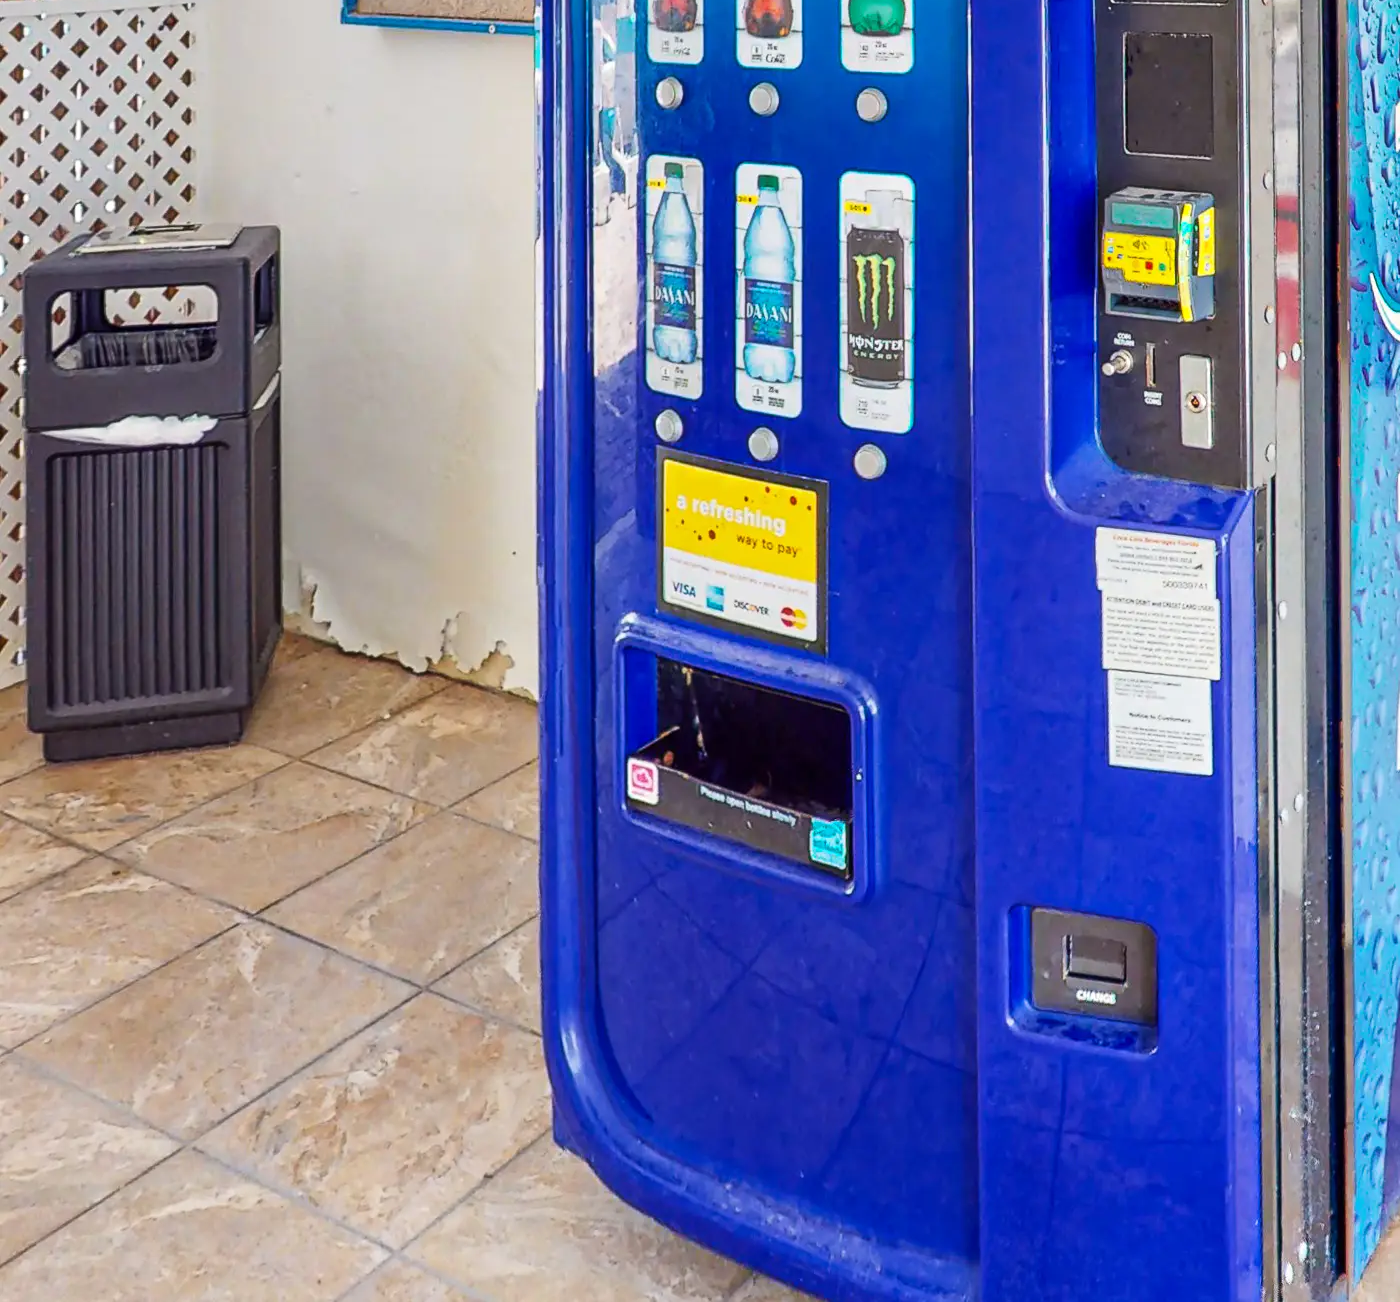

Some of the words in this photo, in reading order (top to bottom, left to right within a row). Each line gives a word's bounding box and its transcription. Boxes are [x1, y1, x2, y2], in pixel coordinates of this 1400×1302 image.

[655, 285, 695, 306] DASANI
[746, 302, 792, 323] DASANI
[853, 350, 899, 360] ENERGY
[677, 495, 687, 511] a
[692, 499, 786, 537] refreshing
[737, 534, 758, 549] way
[762, 539, 774, 551] to
[777, 543, 799, 558] pay
[672, 582, 697, 598] VISA
[733, 599, 770, 616] DISCOVER
[1075, 989, 1117, 1006] CHANGE
